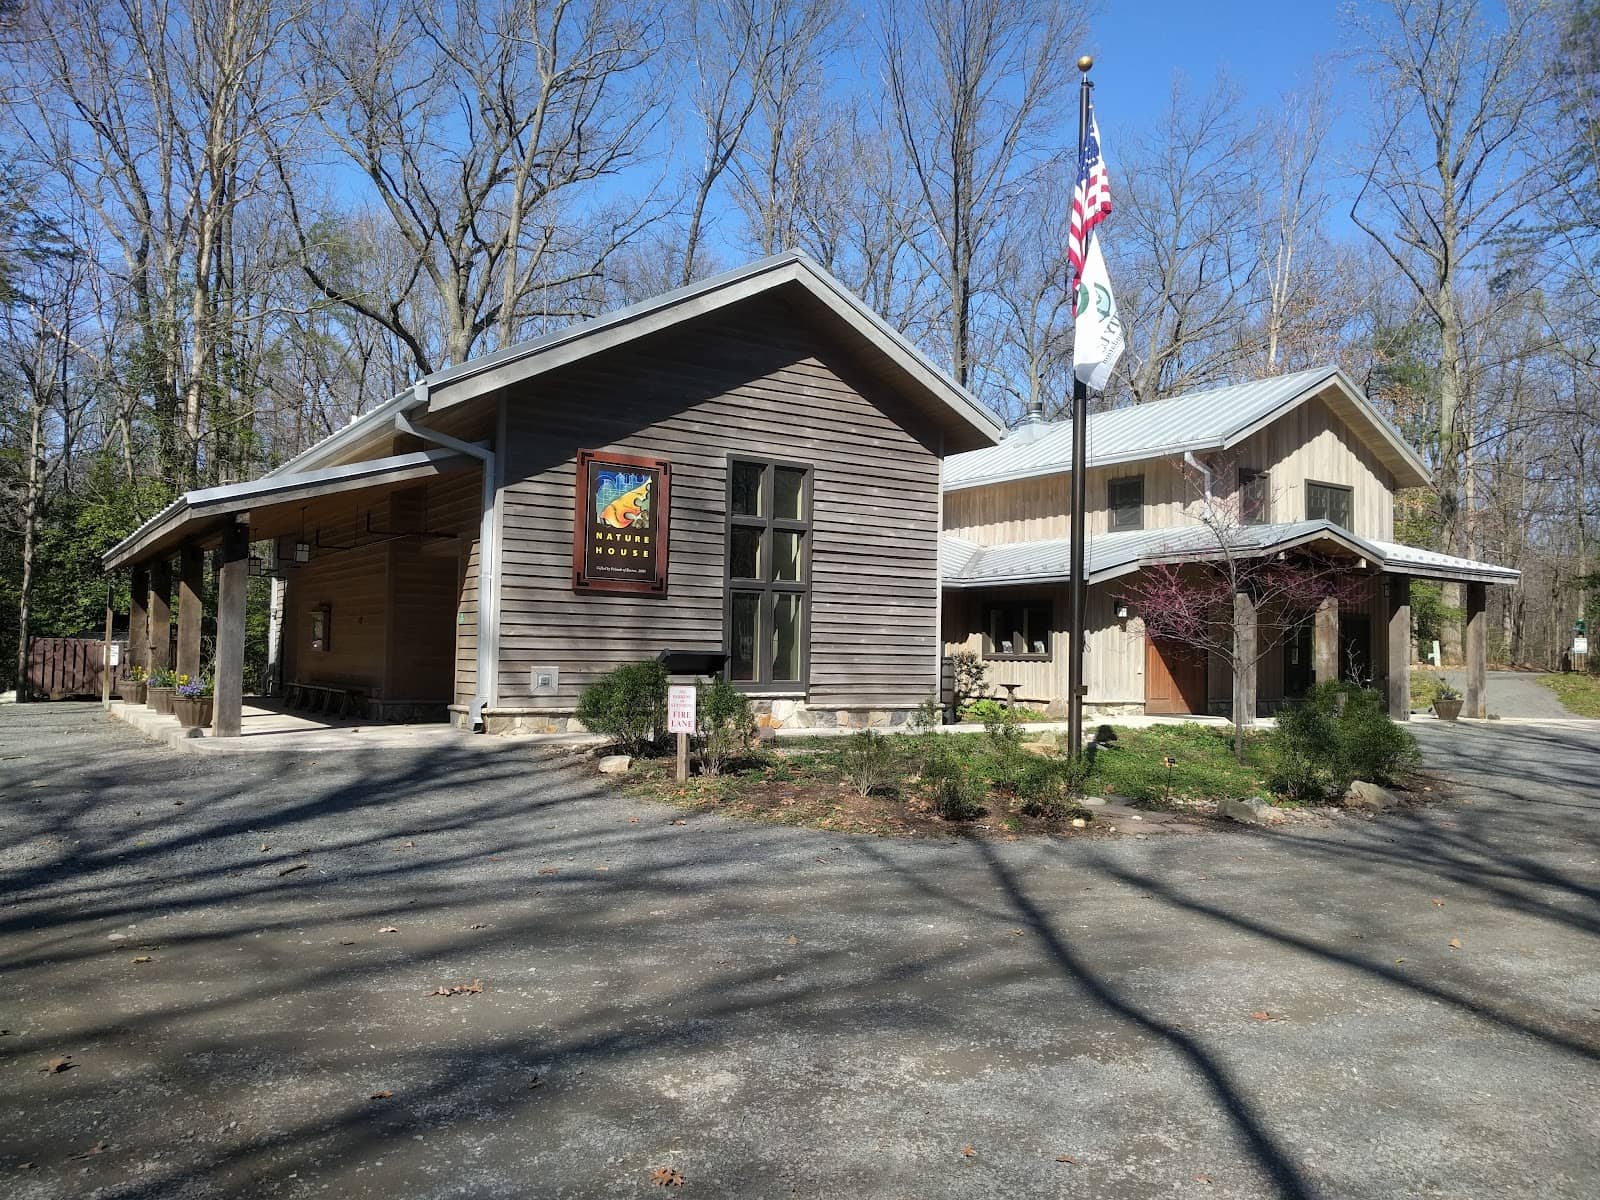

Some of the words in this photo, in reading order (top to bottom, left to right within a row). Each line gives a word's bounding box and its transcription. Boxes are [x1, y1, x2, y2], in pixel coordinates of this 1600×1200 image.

[595, 531, 650, 544] NATURE
[595, 546, 649, 558] HOUSE
[672, 711, 692, 719] FIRE
[671, 719, 693, 728] LANE
